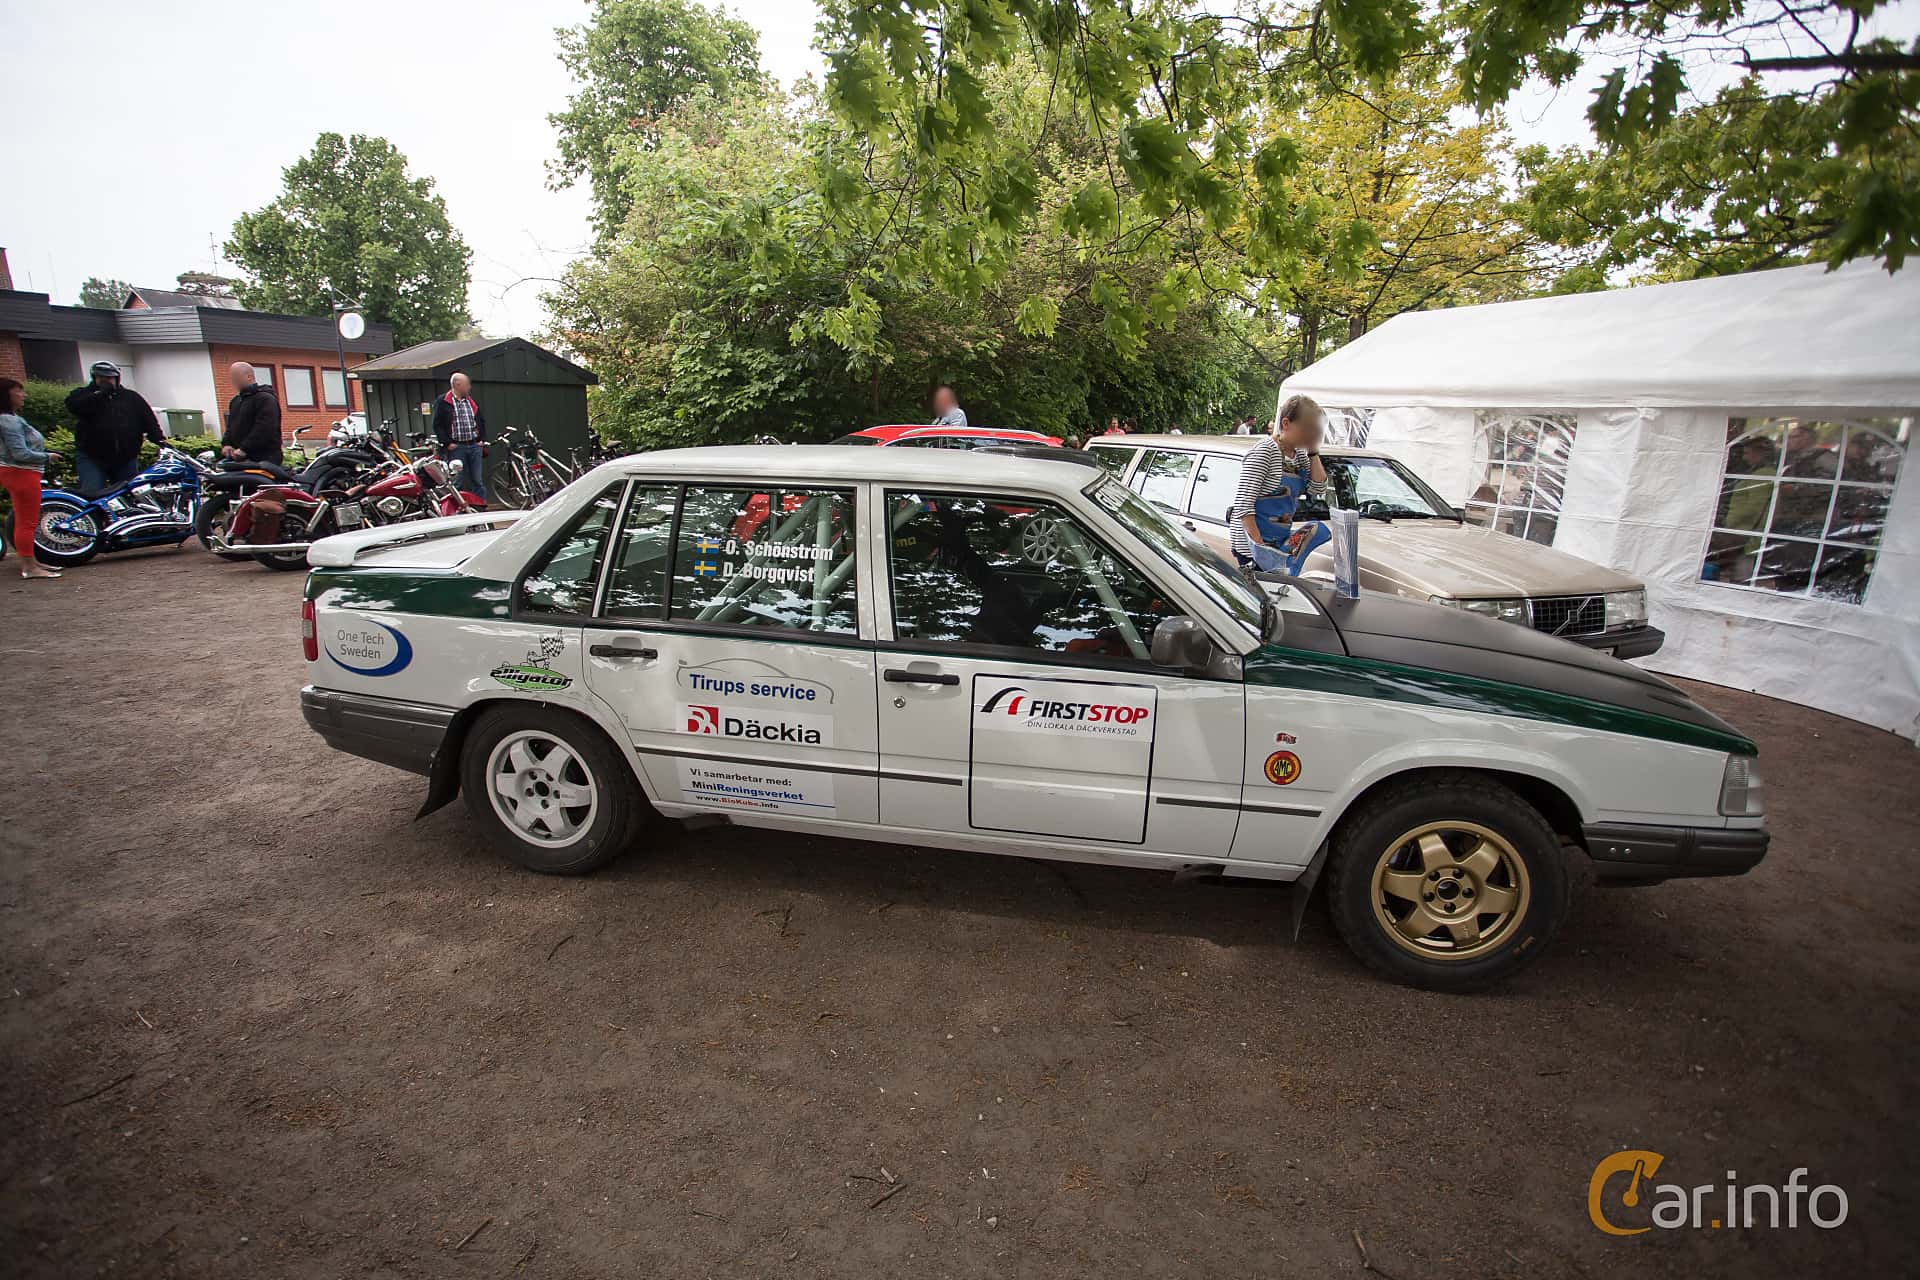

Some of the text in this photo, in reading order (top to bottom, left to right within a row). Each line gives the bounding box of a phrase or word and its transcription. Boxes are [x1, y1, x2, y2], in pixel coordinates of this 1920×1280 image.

[725, 539, 834, 561] O. Schönström
[723, 561, 815, 583] D. Borgqvist
[337, 629, 385, 645] One Tech
[340, 643, 381, 659] Sweden
[689, 673, 816, 701] Tirups service
[1029, 700, 1149, 724] FIRSTSTOP
[724, 717, 821, 745] Däckia
[1027, 720, 1137, 736] DIN LOKALA DÄCKVERKSTAD
[690, 767, 792, 787] Vi samarbetar med:
[692, 780, 804, 801] MiniReningsverket
